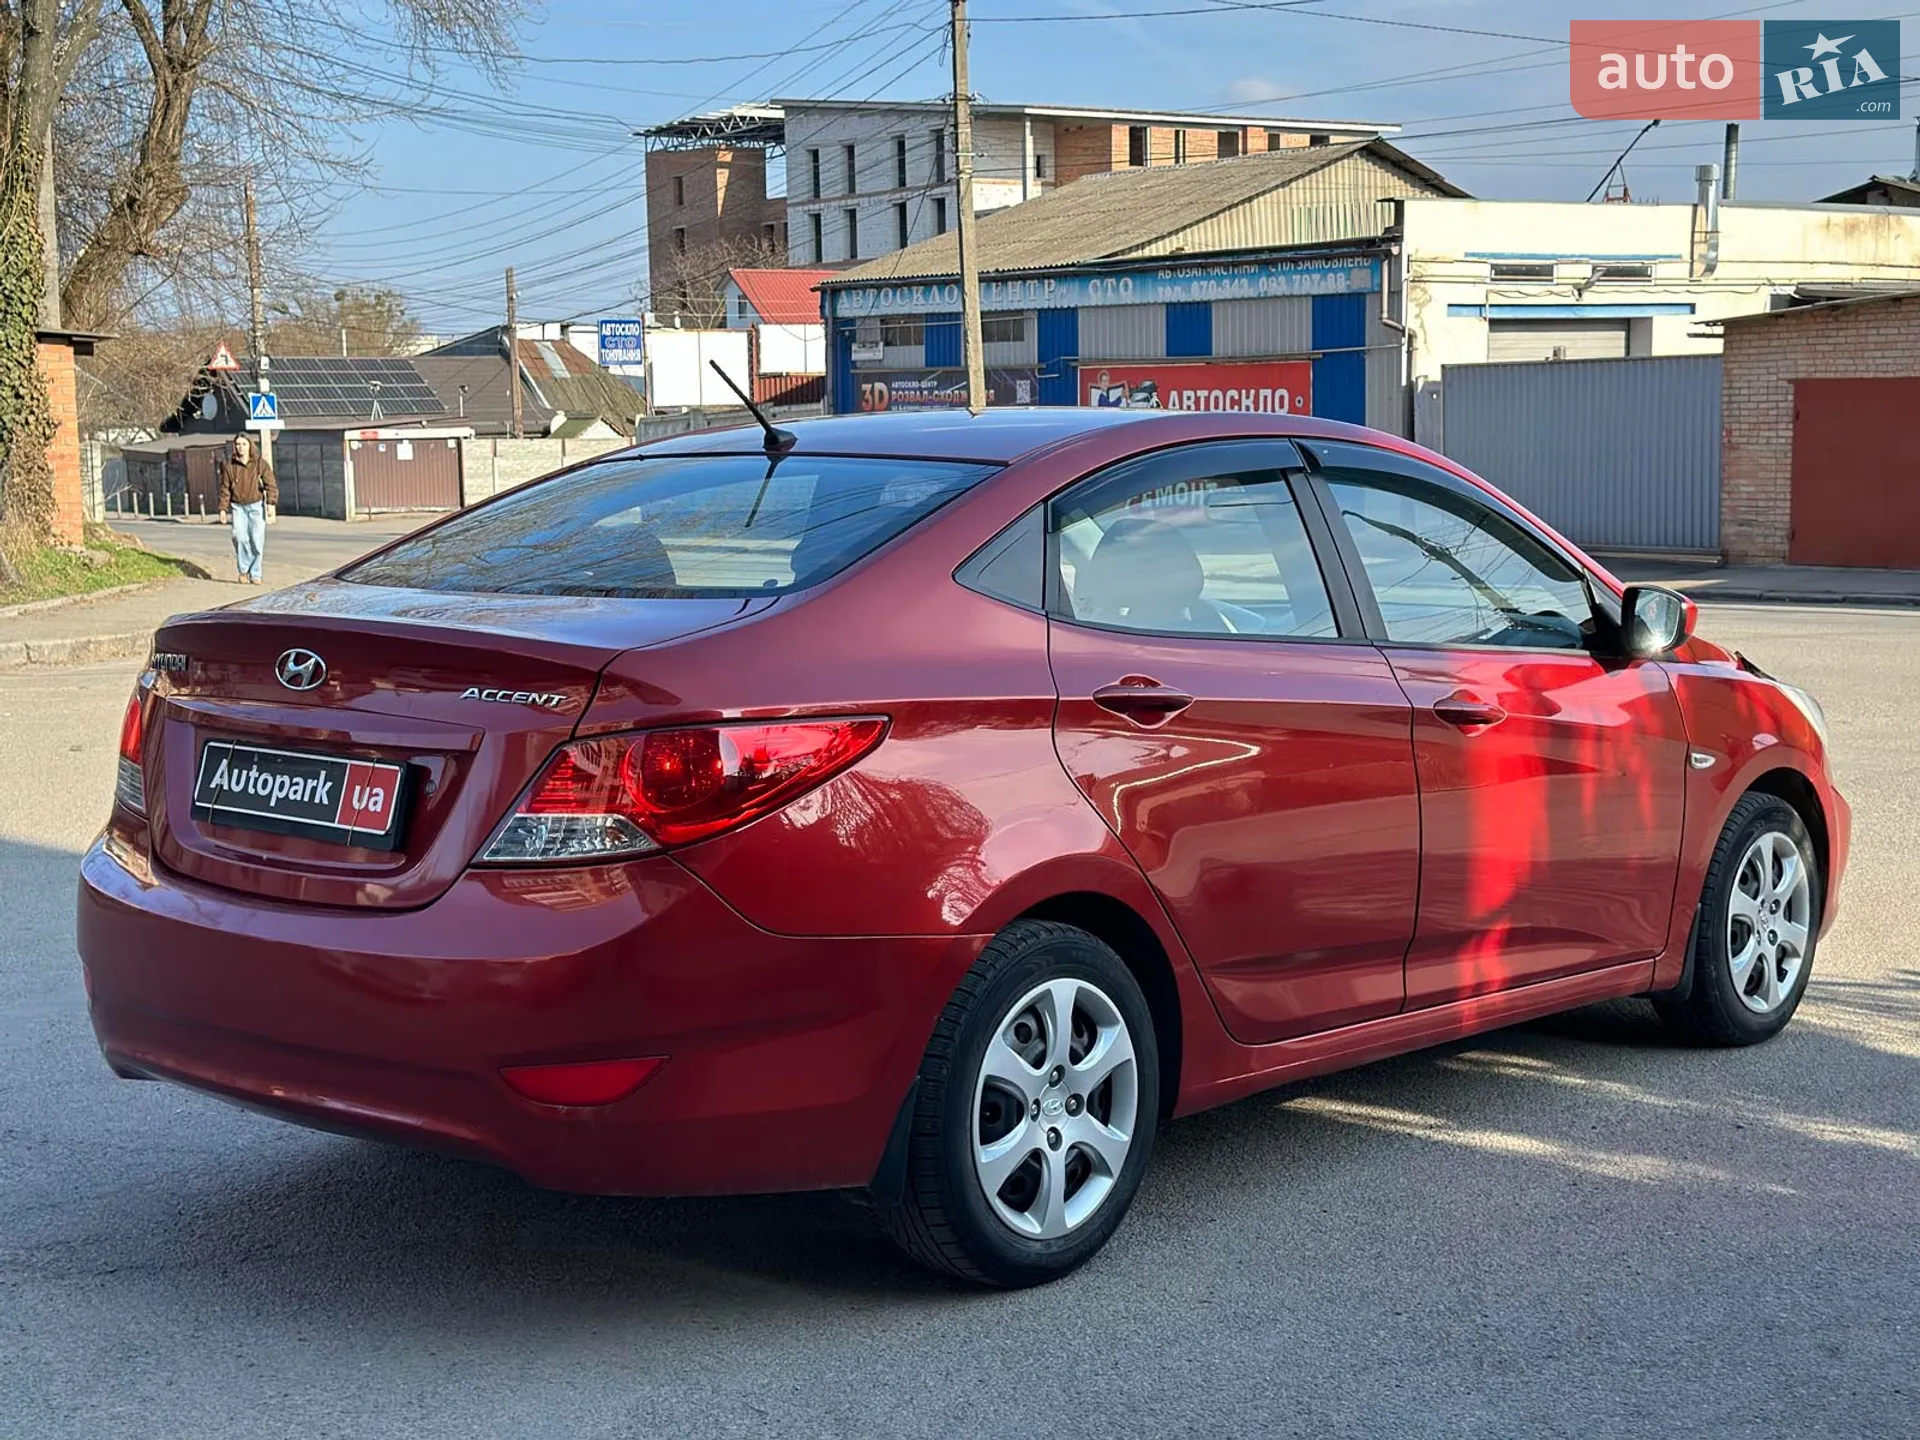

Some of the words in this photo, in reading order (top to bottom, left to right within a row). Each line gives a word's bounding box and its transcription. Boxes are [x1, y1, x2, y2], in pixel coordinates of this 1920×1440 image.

[837, 283, 959, 309] АВТОСКЛО
[1088, 276, 1133, 301] СТО
[601, 322, 640, 336] АВТОСКЛО
[605, 337, 636, 348] СТО
[861, 381, 890, 412] 3D
[1168, 388, 1289, 413] АВТОСКЛО
[460, 687, 566, 709] ACCENT
[210, 758, 333, 807] Autopark
[352, 781, 384, 813] ua
